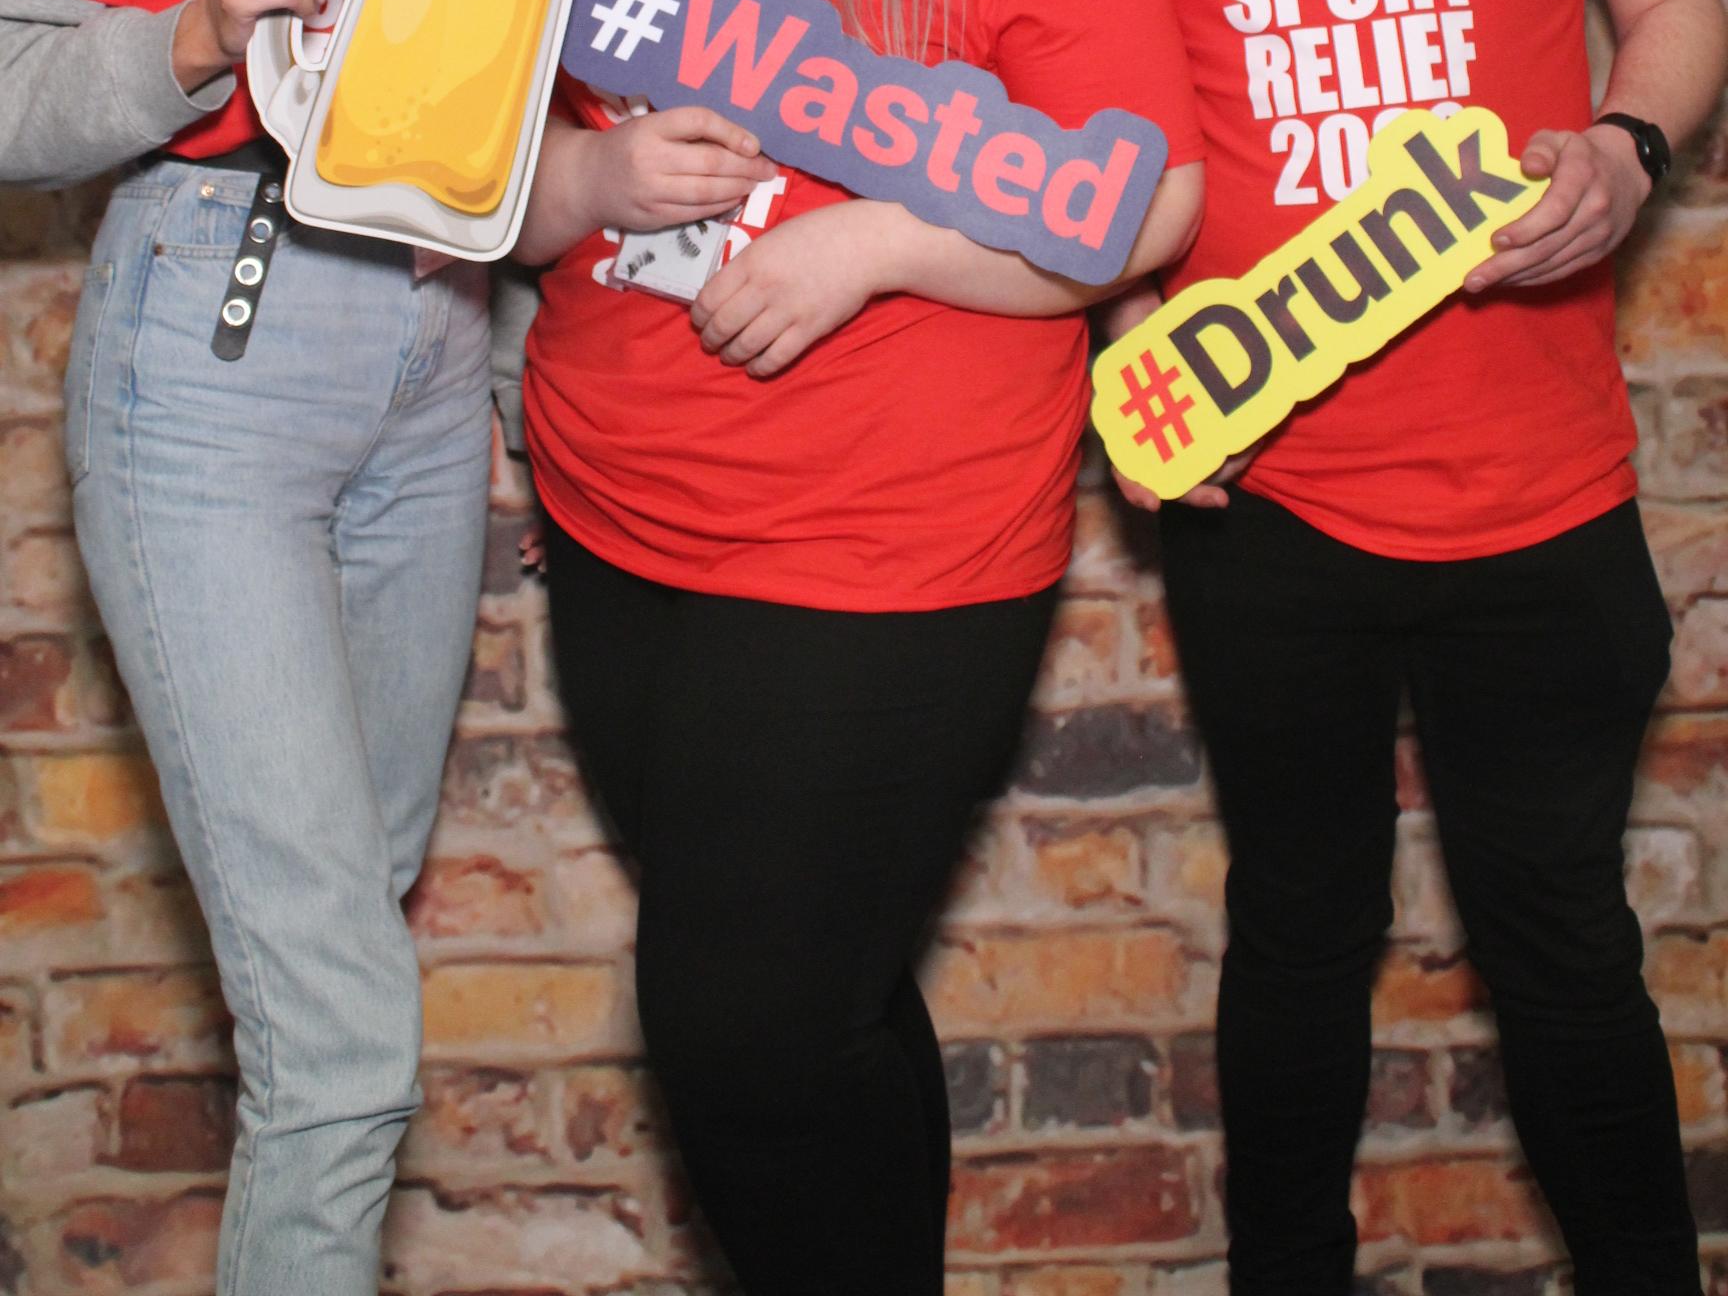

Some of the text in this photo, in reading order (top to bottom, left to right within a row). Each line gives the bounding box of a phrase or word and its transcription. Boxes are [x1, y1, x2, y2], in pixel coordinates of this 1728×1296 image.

[1244, 10, 1477, 120] RELIEF
[1270, 101, 1466, 206] 20
[1119, 130, 1528, 462] #Drunk
